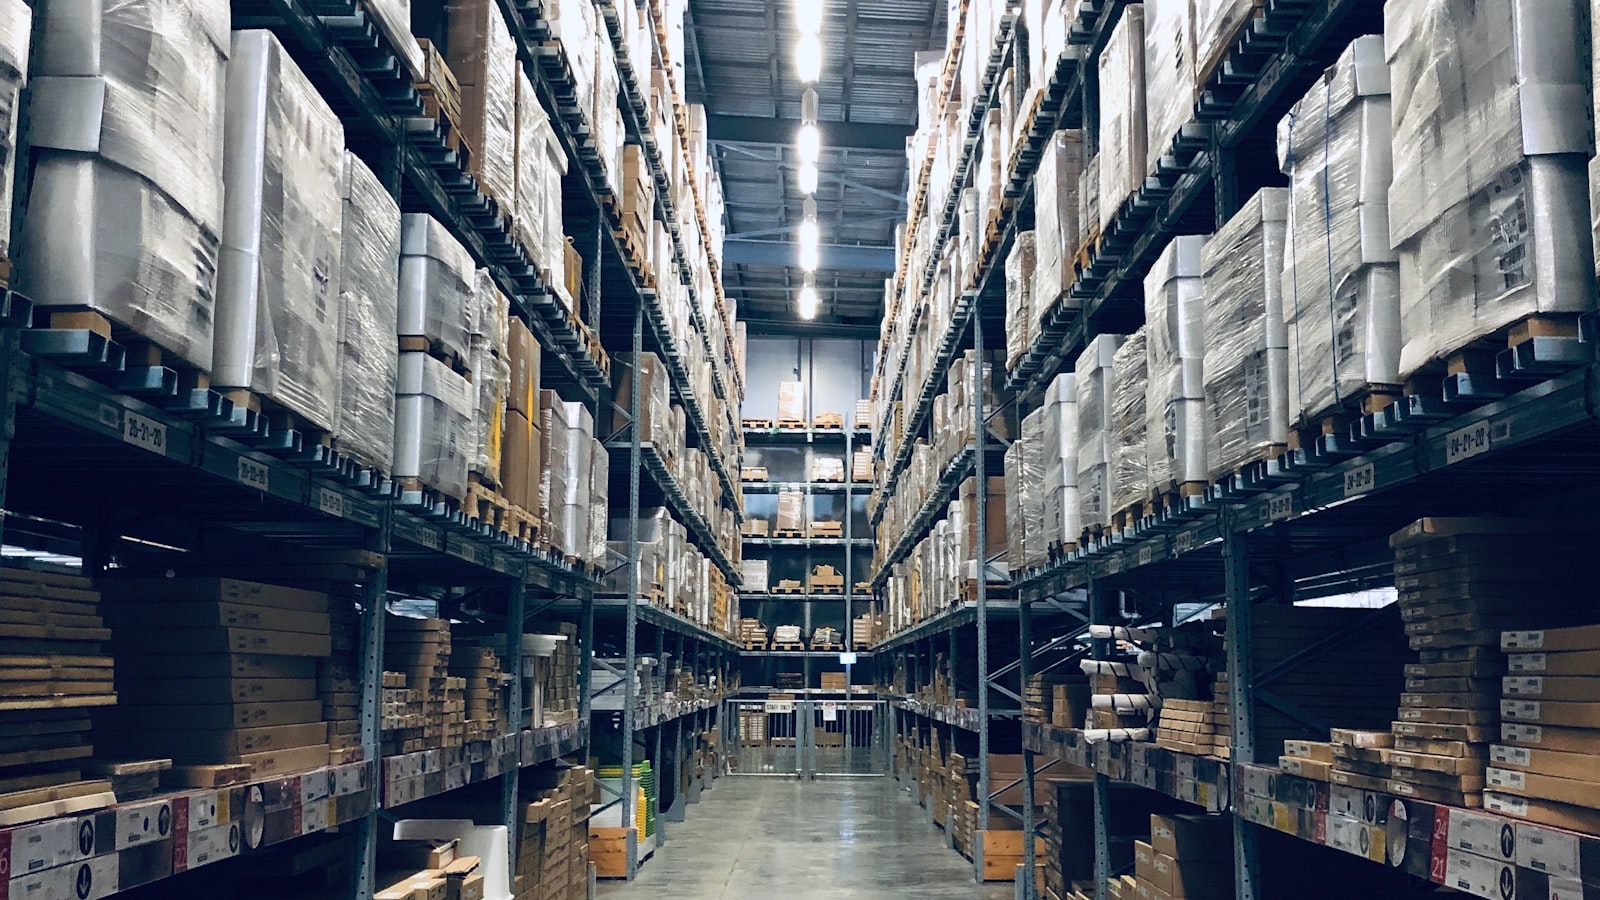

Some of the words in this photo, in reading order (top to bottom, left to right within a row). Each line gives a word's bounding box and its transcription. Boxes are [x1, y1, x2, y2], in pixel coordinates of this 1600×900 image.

[1451, 426, 1485, 457] 24-21-20
[1434, 818, 1447, 840] 24
[1431, 856, 1444, 879] 21
